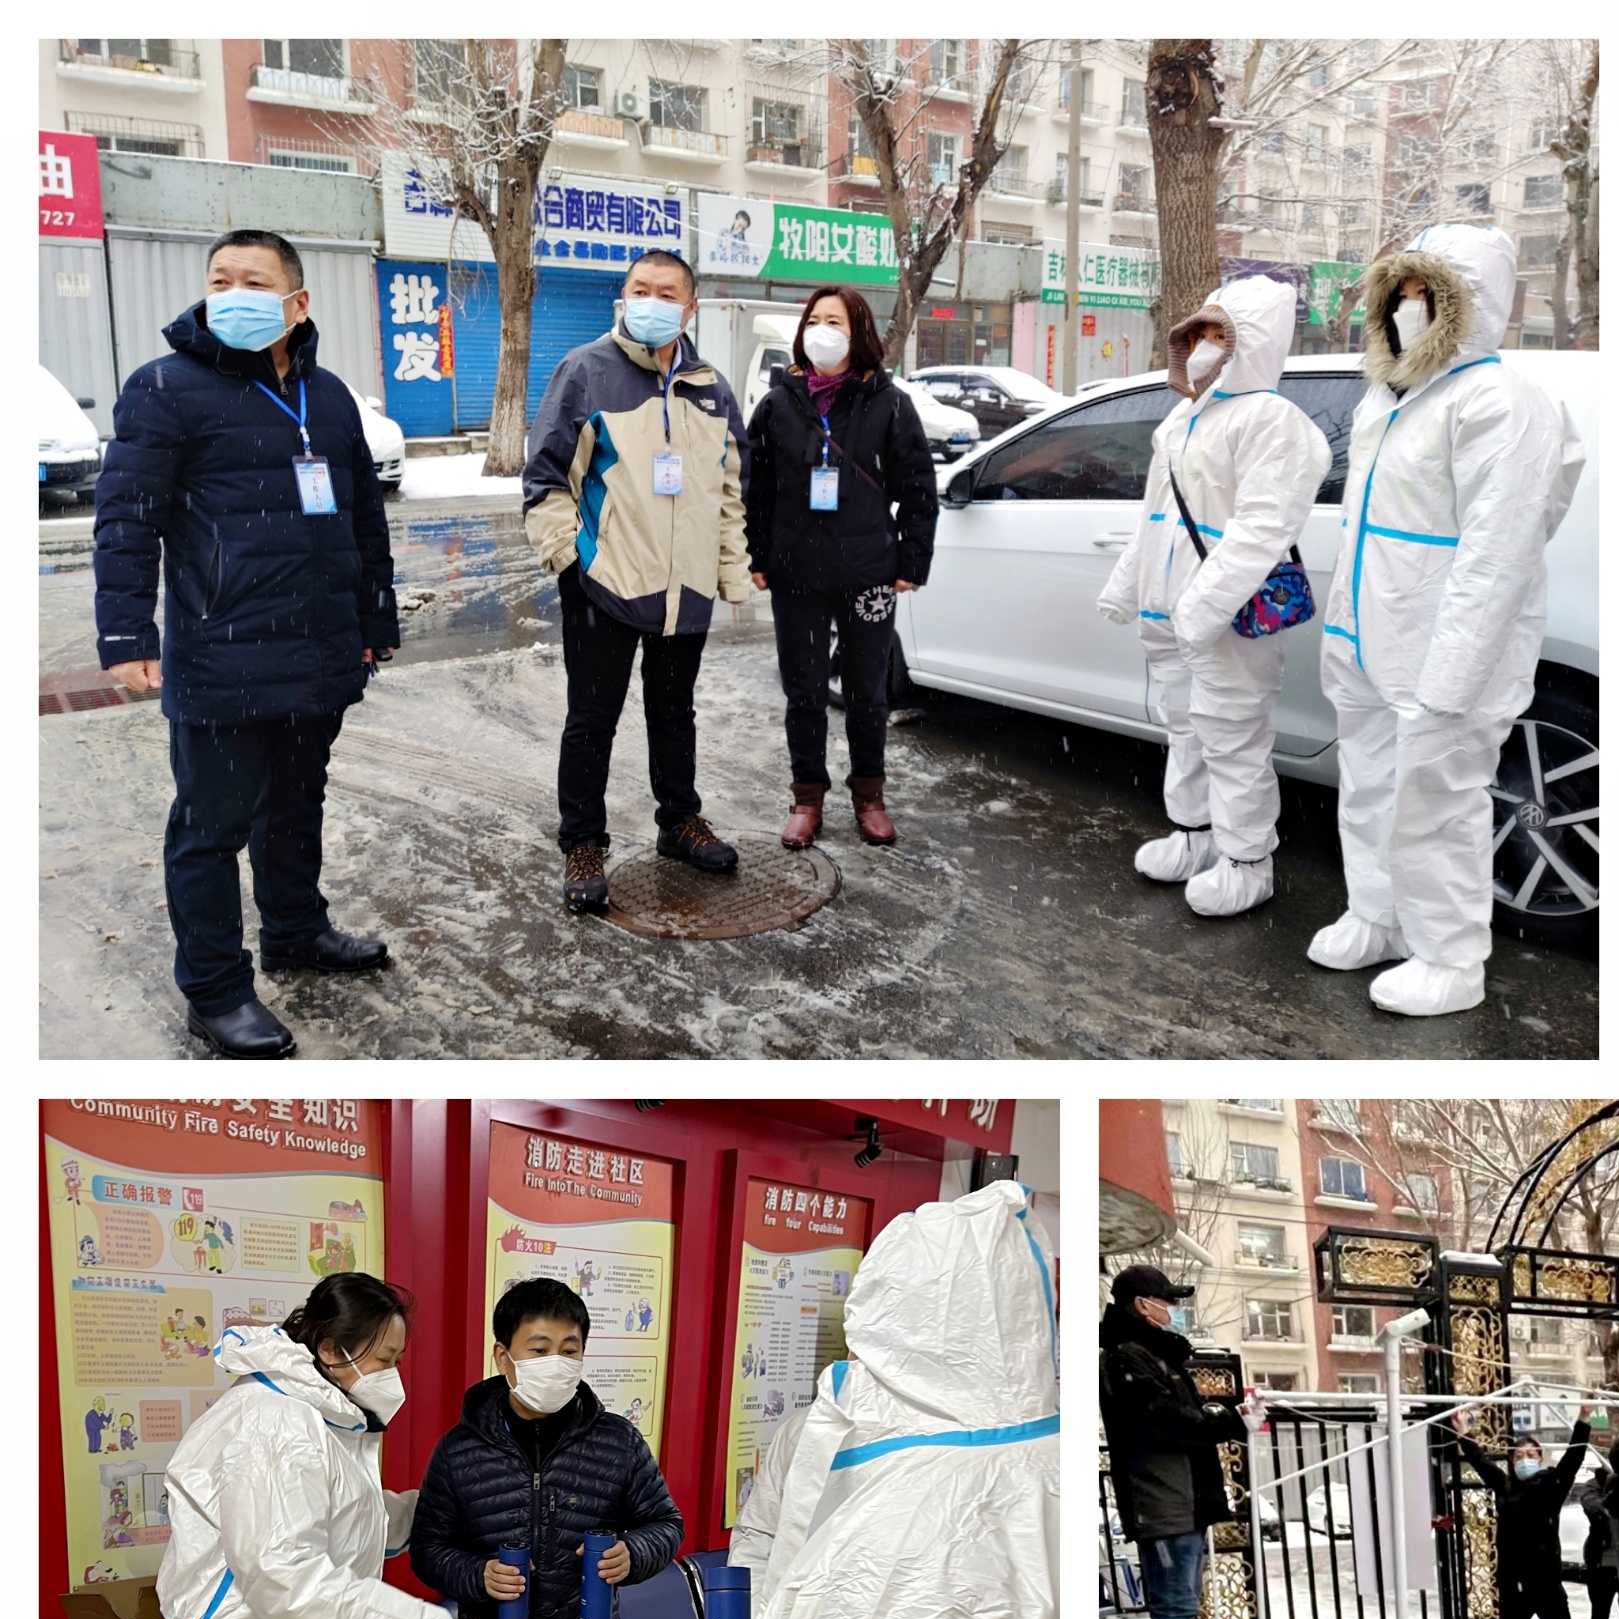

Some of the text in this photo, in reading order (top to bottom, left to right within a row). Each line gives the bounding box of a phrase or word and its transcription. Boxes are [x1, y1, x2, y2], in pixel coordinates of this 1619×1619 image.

[40, 210, 75, 226] 727
[389, 273, 442, 382] 批发
[71, 1099, 366, 1158] Community Fire Safety Knowledge
[527, 1136, 644, 1184] 消防走进社区
[104, 1181, 172, 1206] 正确报警
[525, 1172, 544, 1188] Fire
[590, 1184, 643, 1206] Community
[765, 1186, 847, 1219] 消防四个能力
[178, 1217, 194, 1236] 119
[764, 1214, 844, 1235] fire four Capabilities
[516, 1238, 552, 1254] 防火10法
